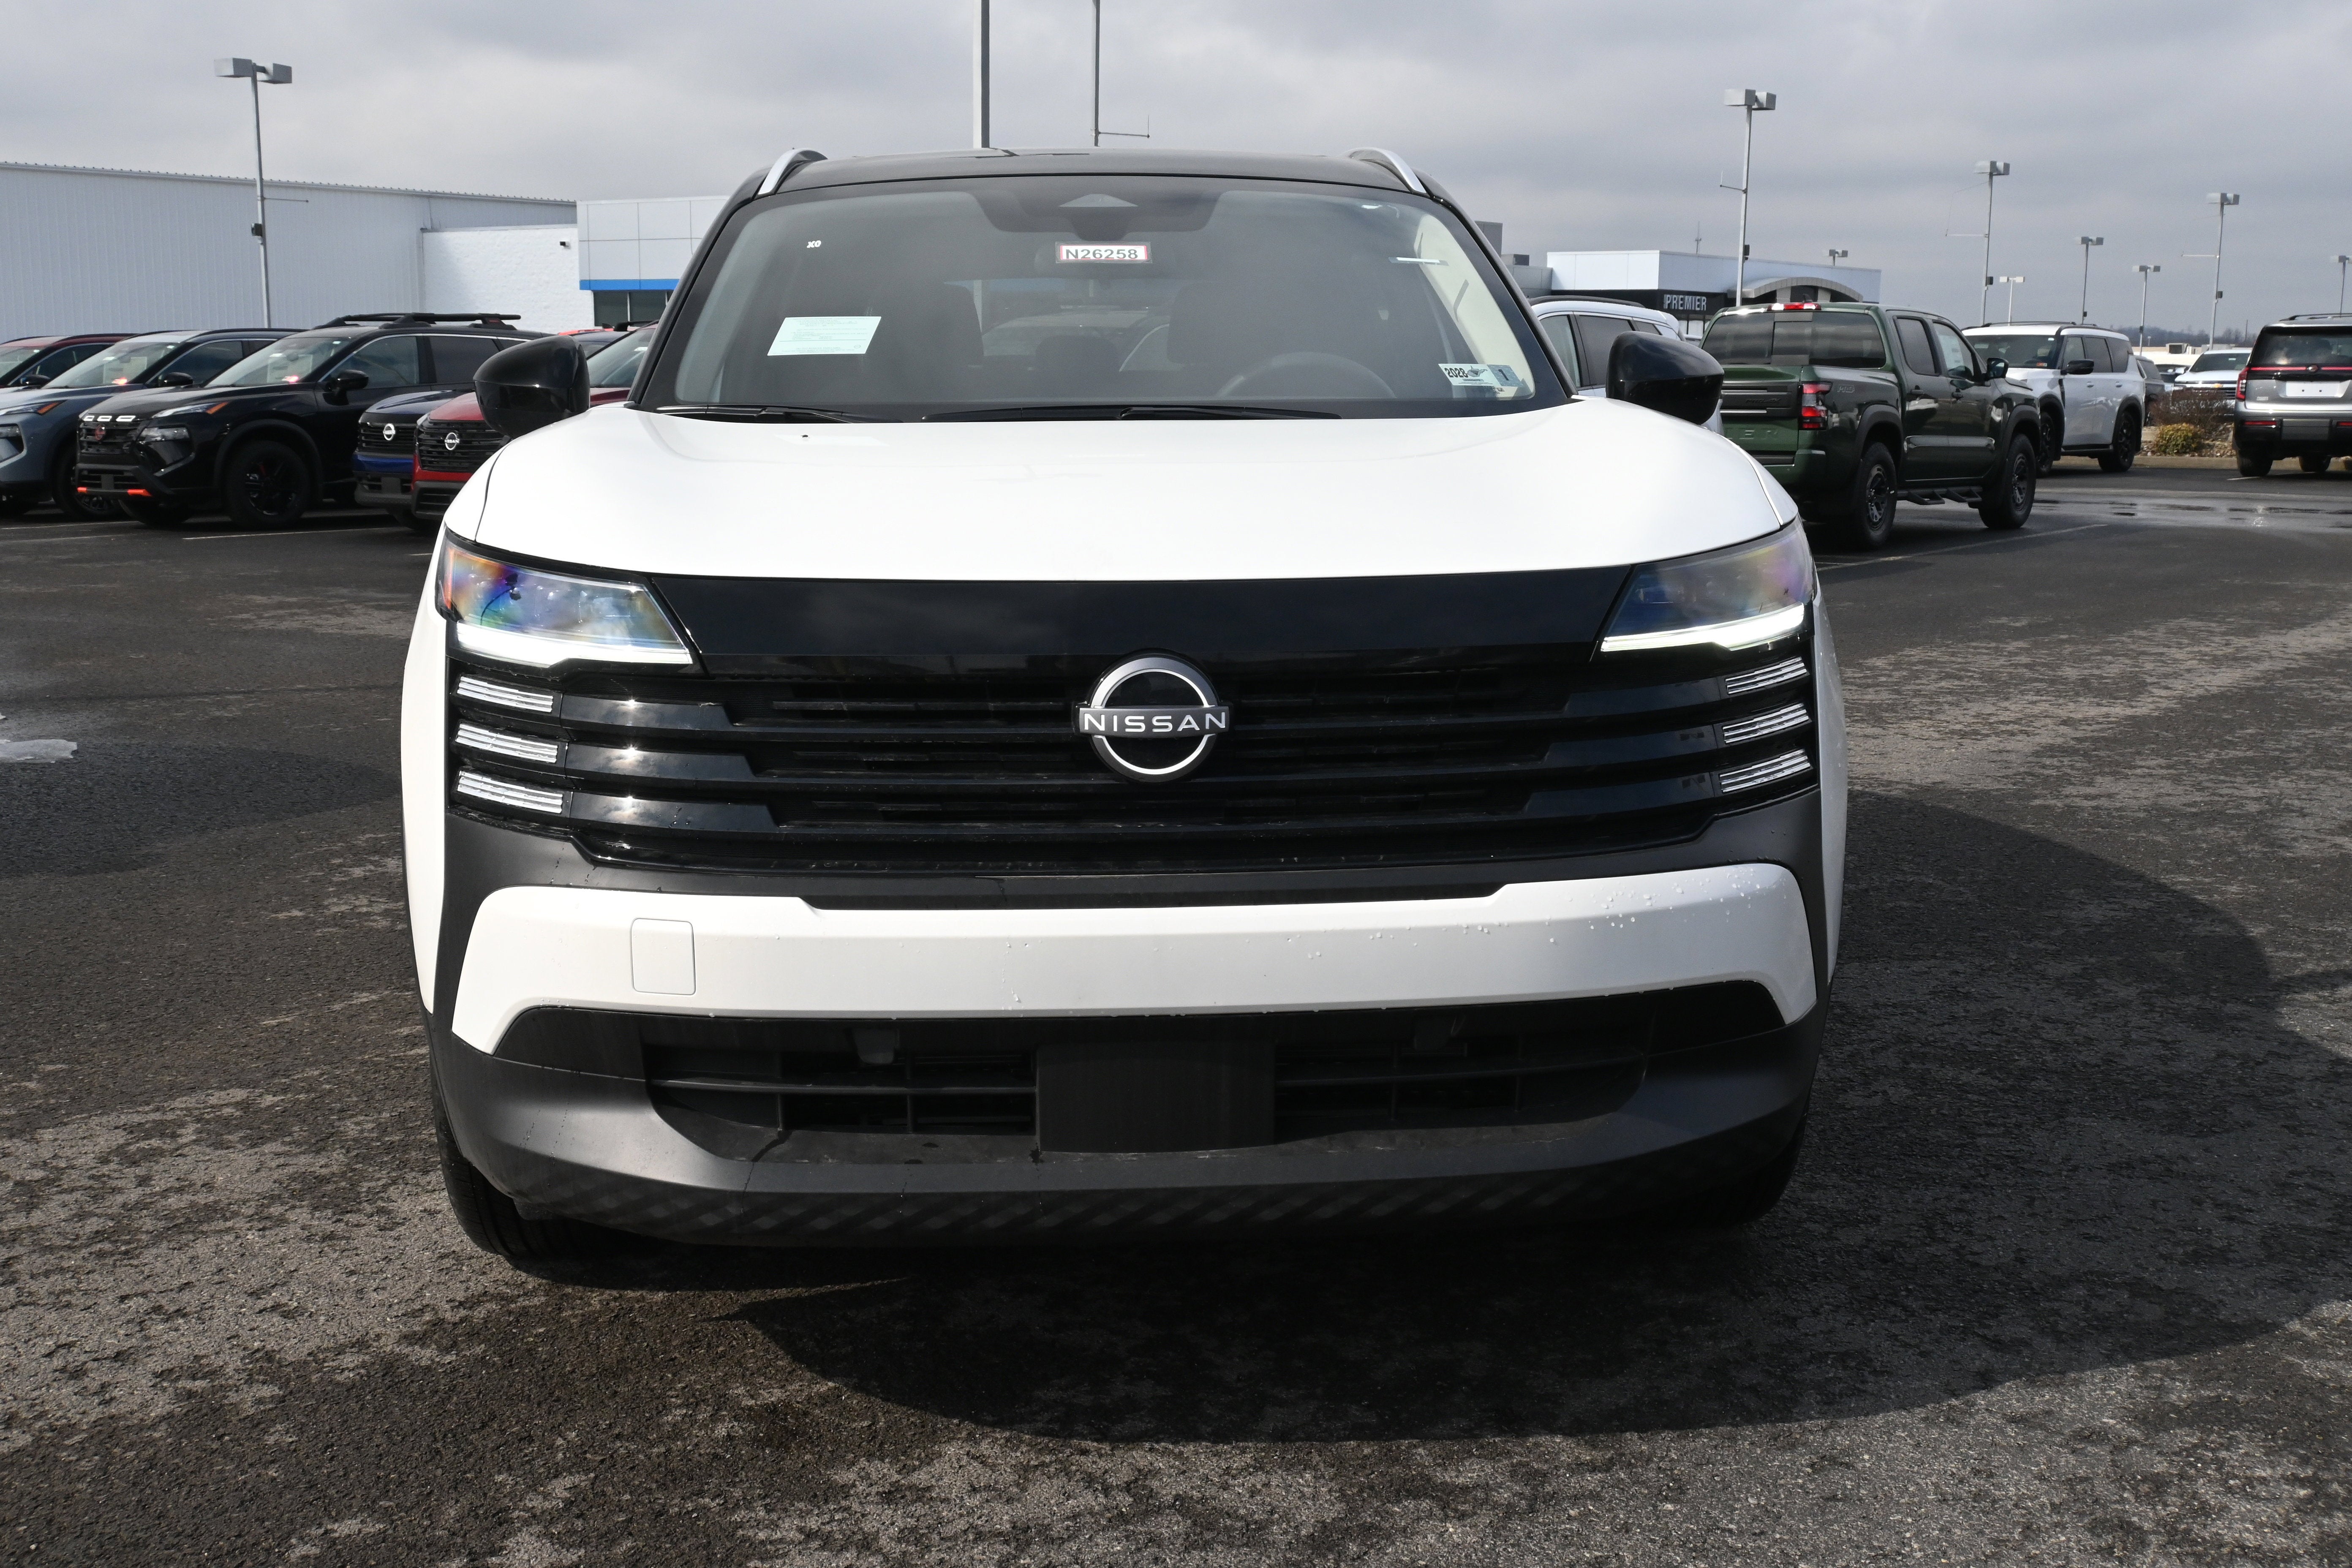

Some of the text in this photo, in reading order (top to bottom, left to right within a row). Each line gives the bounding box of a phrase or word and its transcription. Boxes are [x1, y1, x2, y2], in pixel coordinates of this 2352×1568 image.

[1065, 249, 1138, 259] N26258
[1663, 294, 1707, 311] PREMIER
[1444, 368, 1469, 378] 2028
[1498, 369, 1510, 381] 1
[1084, 712, 1226, 733] NISSAN
